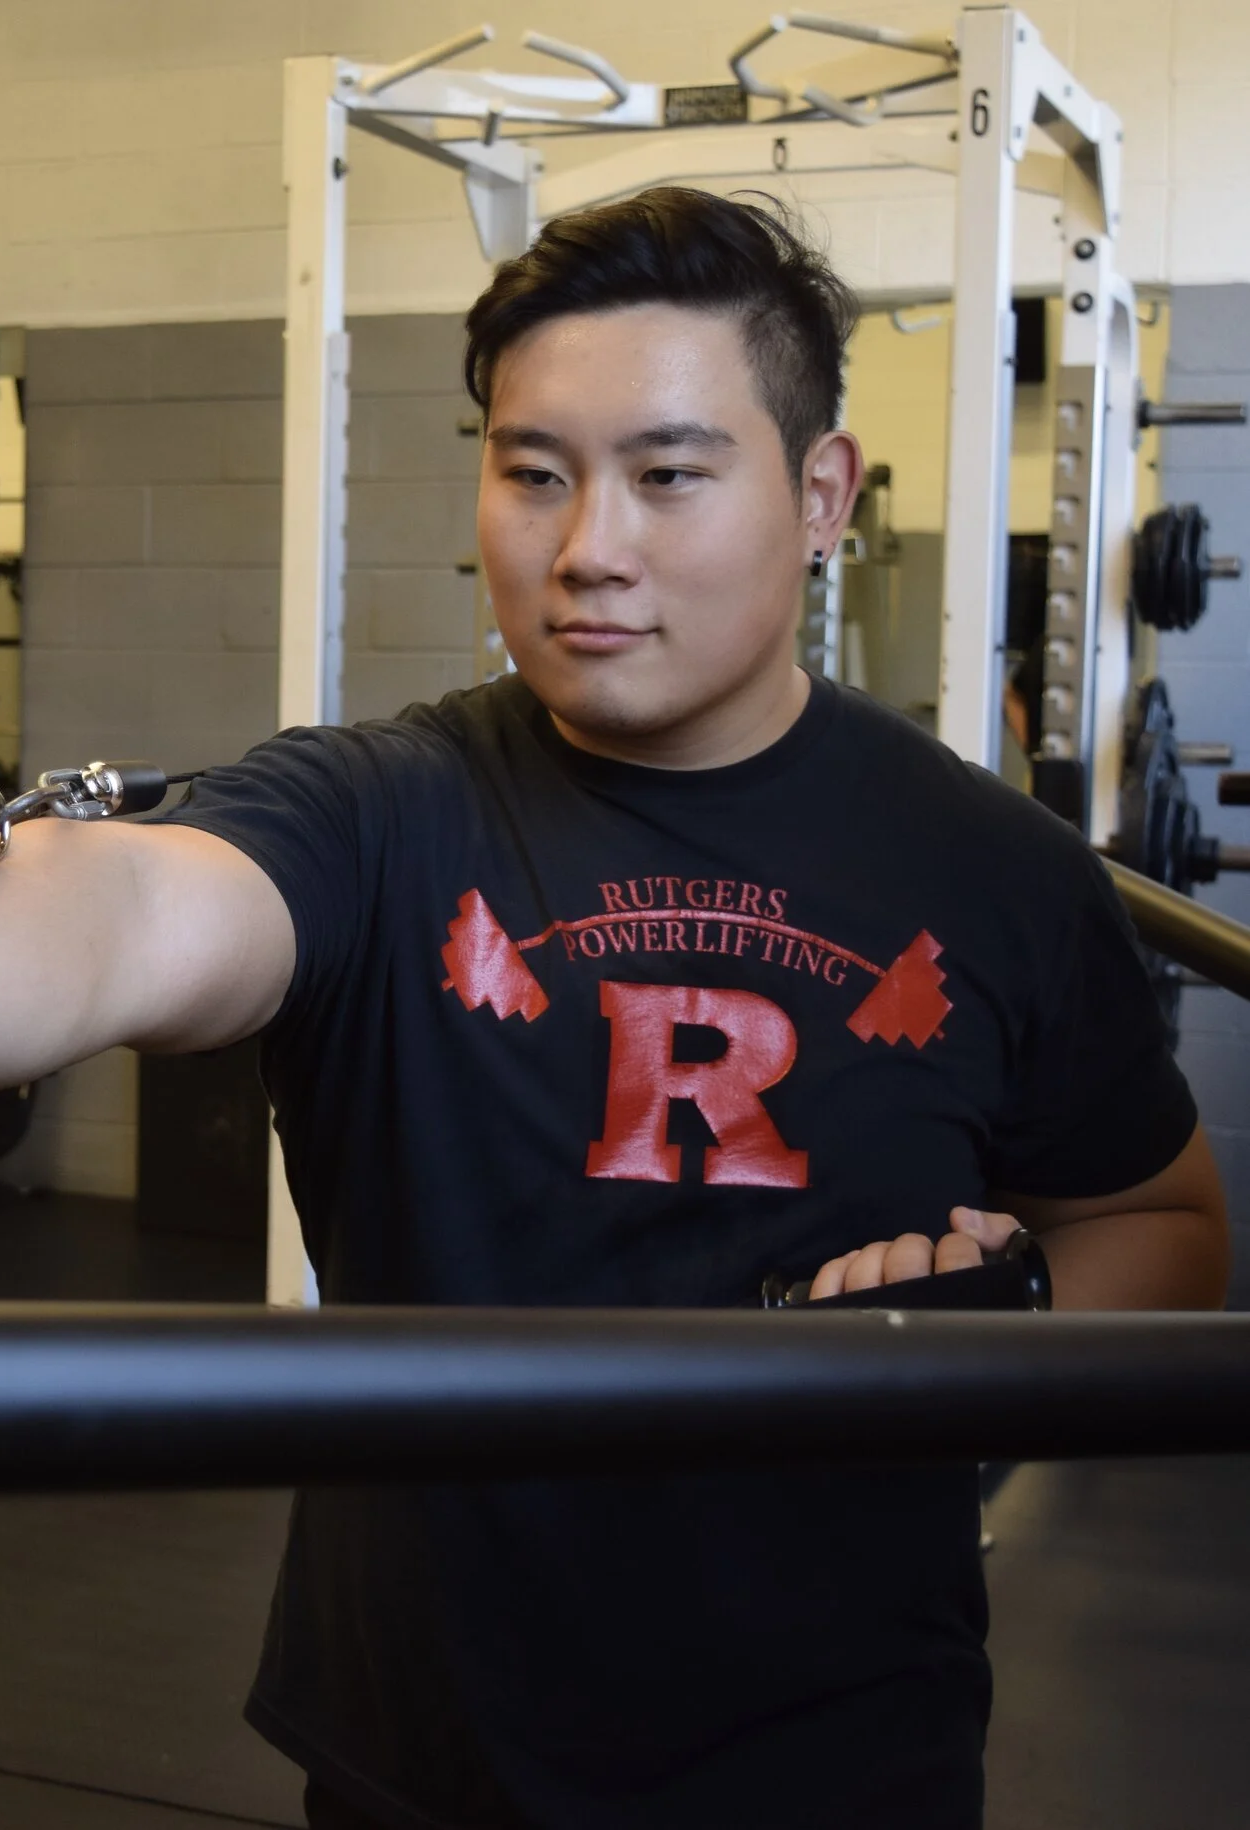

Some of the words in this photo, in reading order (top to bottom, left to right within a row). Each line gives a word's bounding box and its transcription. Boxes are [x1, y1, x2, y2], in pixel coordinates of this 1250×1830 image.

[971, 87, 989, 137] 6
[598, 876, 787, 920] RUTGERS
[585, 979, 809, 1189] R
